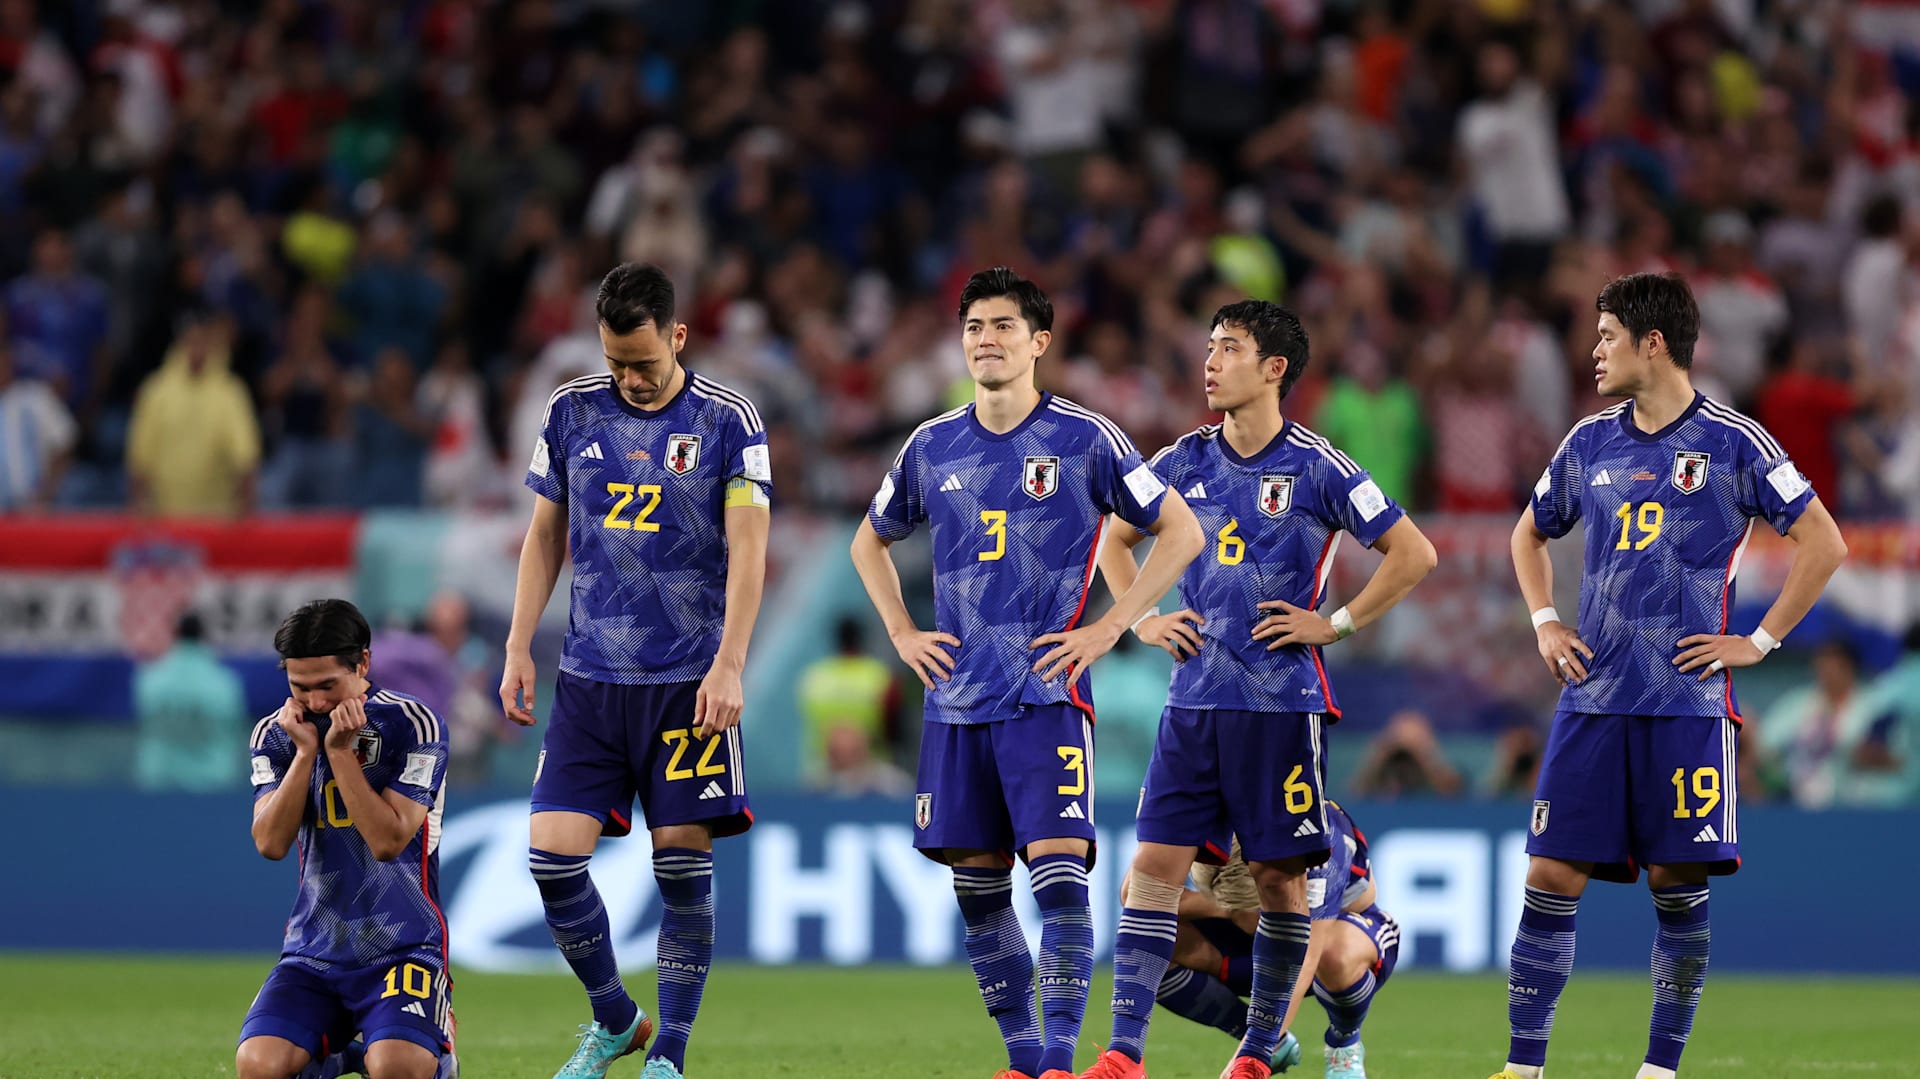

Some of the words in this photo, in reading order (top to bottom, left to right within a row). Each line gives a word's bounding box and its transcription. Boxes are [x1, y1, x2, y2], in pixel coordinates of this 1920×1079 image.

[603, 482, 662, 532] 22
[1615, 501, 1665, 550] 19
[978, 510, 1007, 561] 3
[1217, 518, 1246, 566] 6
[661, 726, 726, 781] 22
[1057, 746, 1085, 796] 3
[316, 779, 355, 829] 0
[1282, 764, 1313, 815] 6
[1671, 767, 1721, 819] 19
[555, 932, 603, 951] APAN
[379, 962, 432, 1000] 10
[979, 979, 1008, 995] PAN
[1039, 976, 1089, 988] JAPAN
[1111, 998, 1136, 1007] PAN
[1507, 982, 1539, 996] PAN
[1657, 979, 1704, 995] JAPA
